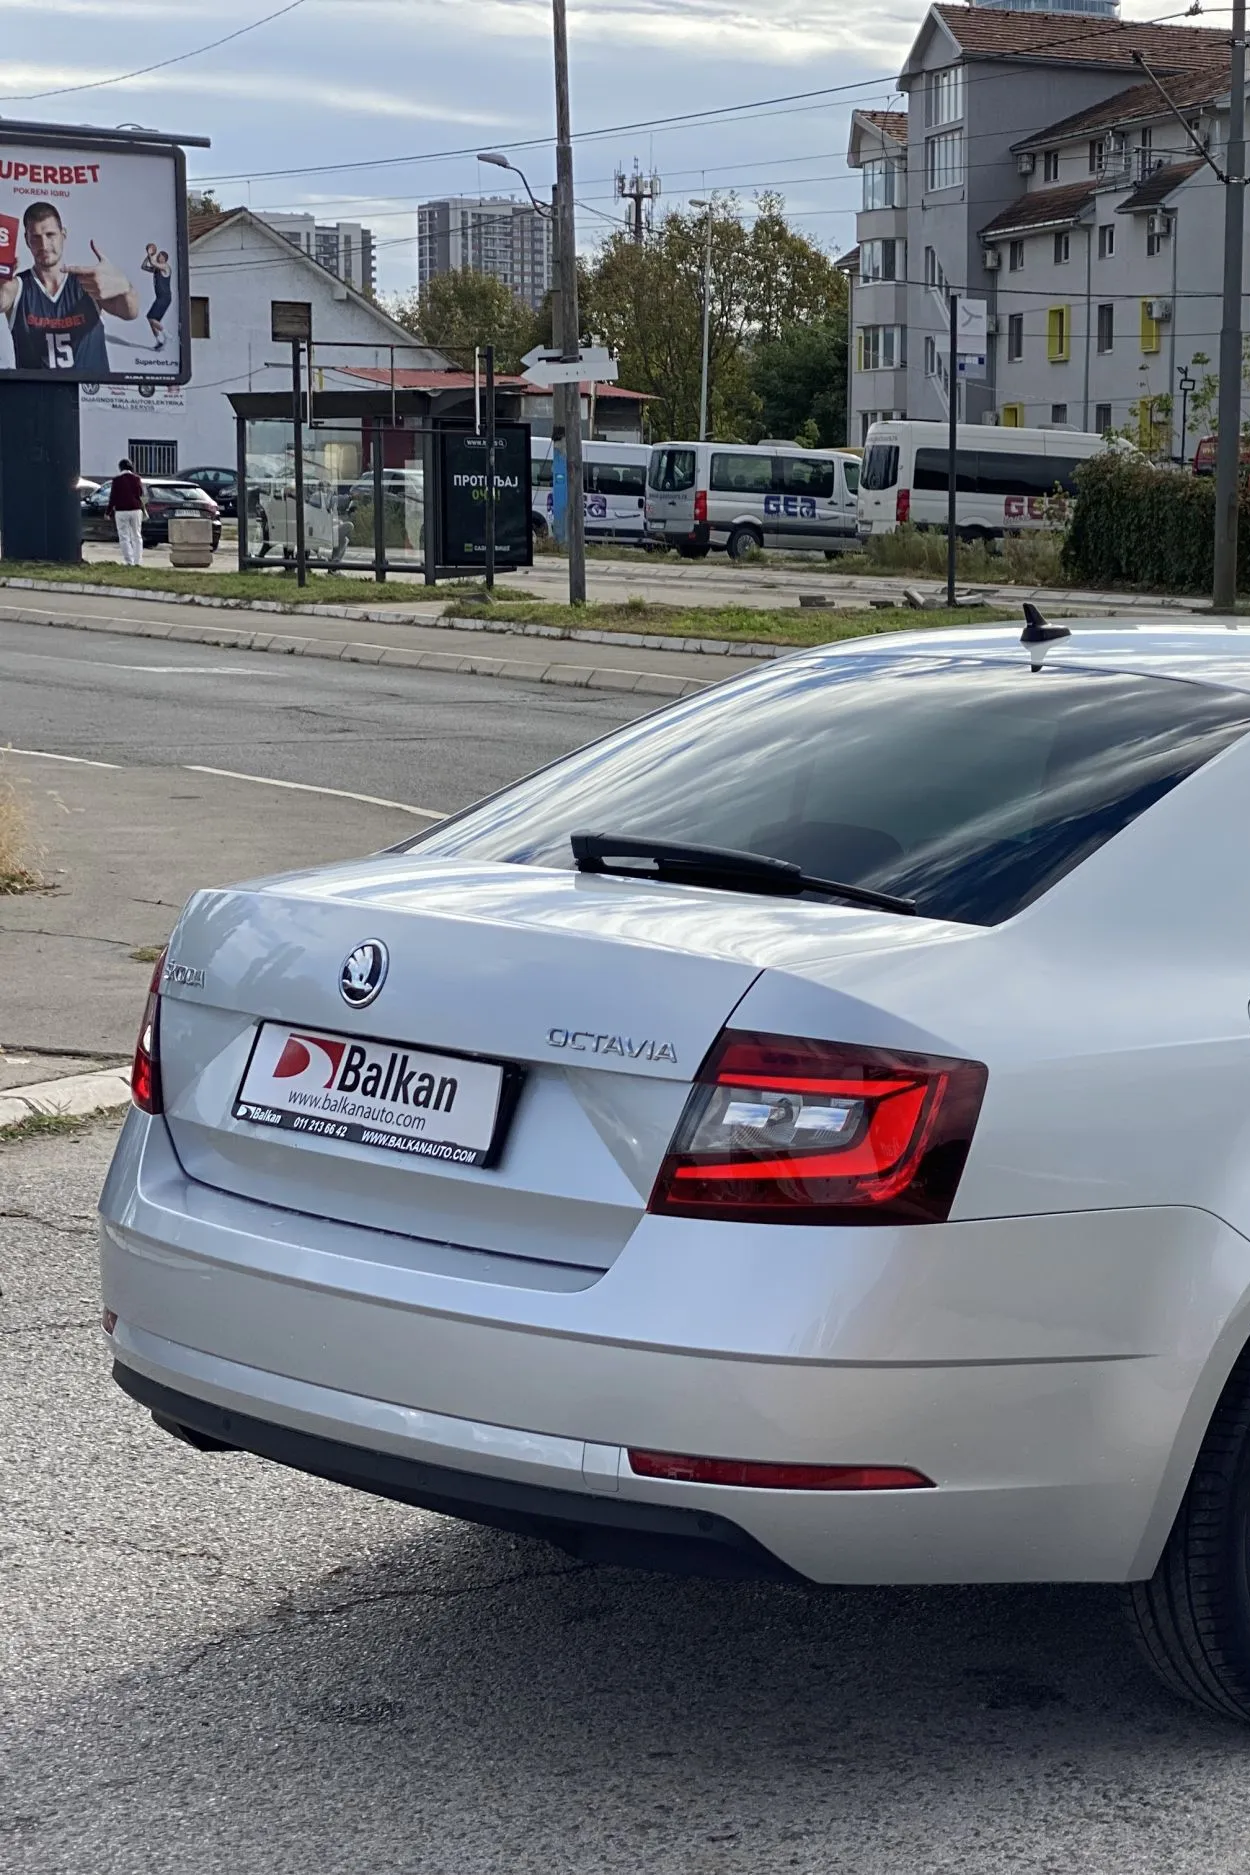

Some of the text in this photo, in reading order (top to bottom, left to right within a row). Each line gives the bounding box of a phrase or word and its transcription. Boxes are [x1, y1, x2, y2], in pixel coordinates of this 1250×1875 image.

[13, 187, 49, 196] POKRENI
[28, 313, 86, 328] SUPERBET
[45, 333, 74, 368] 15
[135, 358, 178, 367] Superbet.rs
[546, 1027, 678, 1064] OCTAVIA
[337, 1044, 459, 1113] Balkan
[287, 1089, 427, 1132] www.balkanauto.com
[252, 1107, 477, 1163] Balkan 011 213 66 42 WWW.BALKANAUTO.COM
